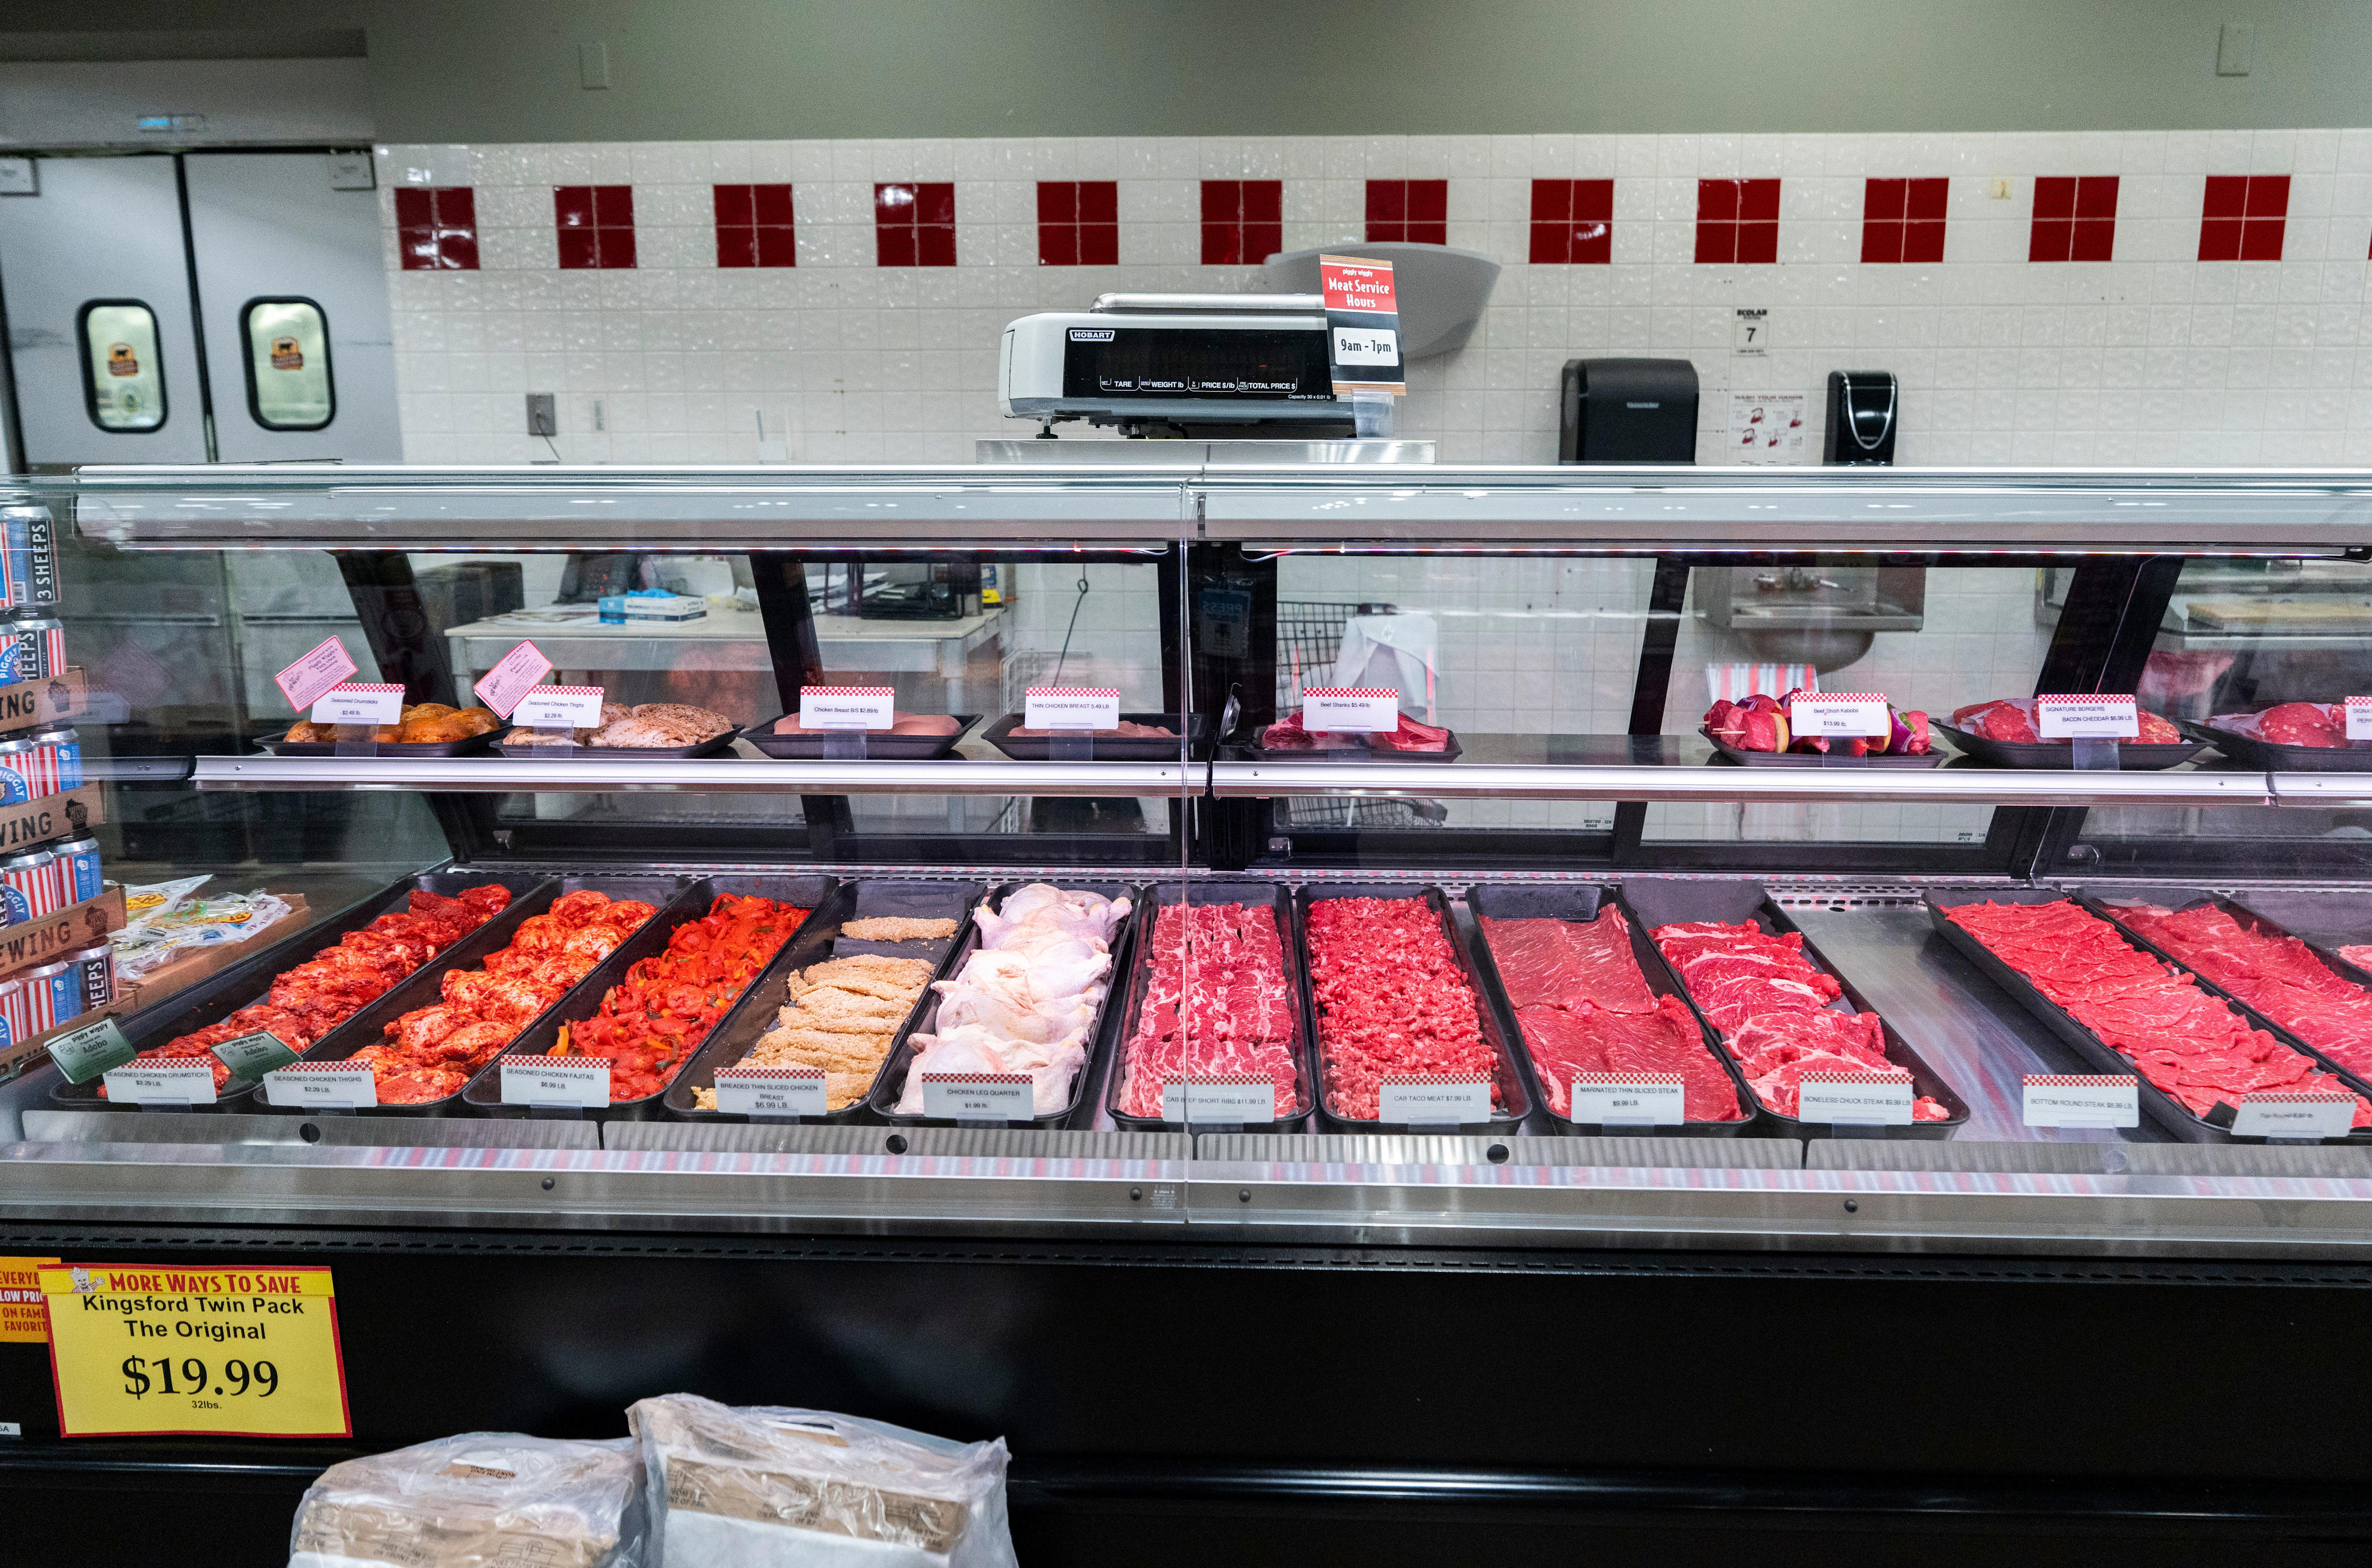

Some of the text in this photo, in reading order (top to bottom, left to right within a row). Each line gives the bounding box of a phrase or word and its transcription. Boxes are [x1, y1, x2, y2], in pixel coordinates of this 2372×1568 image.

[1329, 277, 1390, 294] Meat Service
[1346, 294, 1376, 308] Hours
[1746, 327, 1756, 342] 7
[1341, 339, 1391, 354] 9am 7pm
[31, 524, 52, 599] 3 SHEEPS
[516, 645, 524, 653] with
[72, 1022, 108, 1043] piggly wiggly
[83, 1040, 107, 1055] Adobo
[244, 1046, 268, 1056] Adobo
[109, 1273, 302, 1294] MORE WAYS TO SAVE
[0, 1291, 20, 1302] LOW
[2, 1307, 18, 1318] ON
[83, 1295, 304, 1316] Kingsford Twin Pack
[124, 1320, 266, 1342] The Original
[121, 1355, 279, 1400] $19.99
[191, 1400, 222, 1410] 32lbs.
